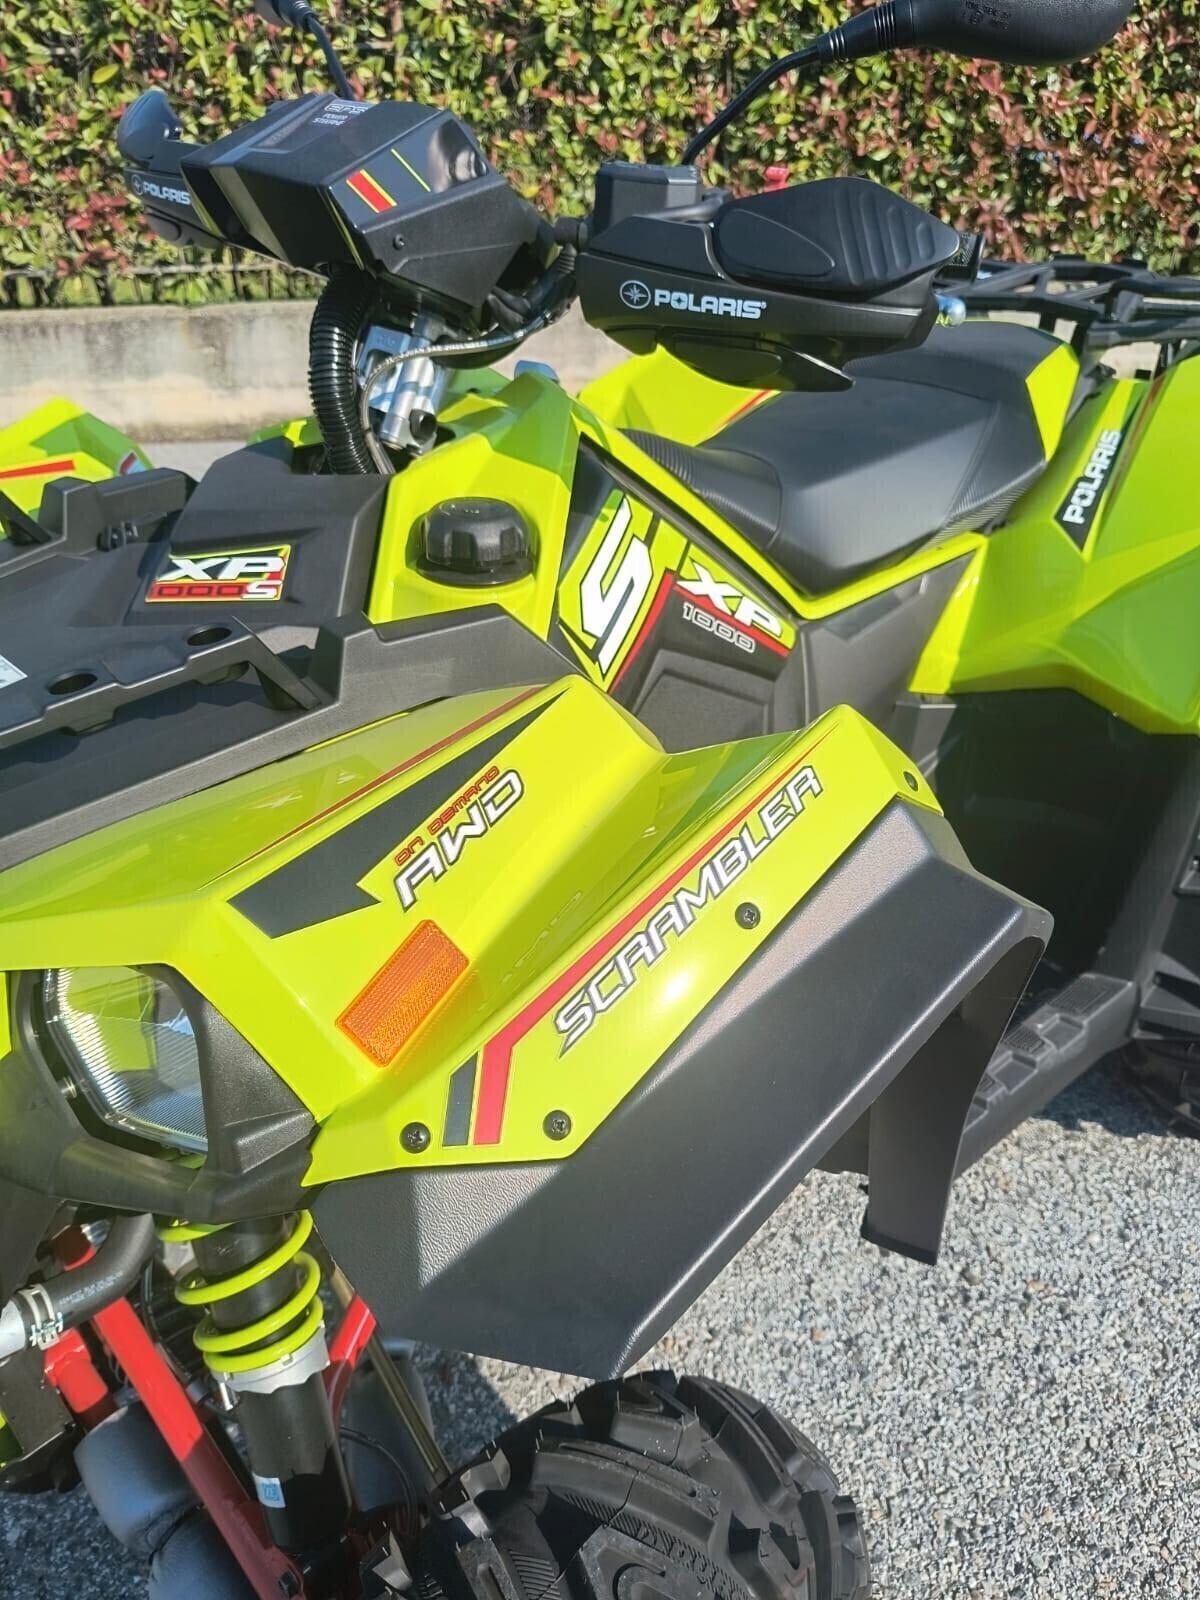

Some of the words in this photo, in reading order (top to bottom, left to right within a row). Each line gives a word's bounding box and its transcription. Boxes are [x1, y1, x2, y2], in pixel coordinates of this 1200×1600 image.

[143, 181, 191, 205] POLARIS
[1062, 429, 1121, 524] POLARIS
[157, 557, 284, 580] XP
[677, 562, 782, 637] XP
[682, 601, 755, 654] 1000
[393, 769, 524, 913] AWD
[554, 765, 823, 1058] SCRAMBLER
